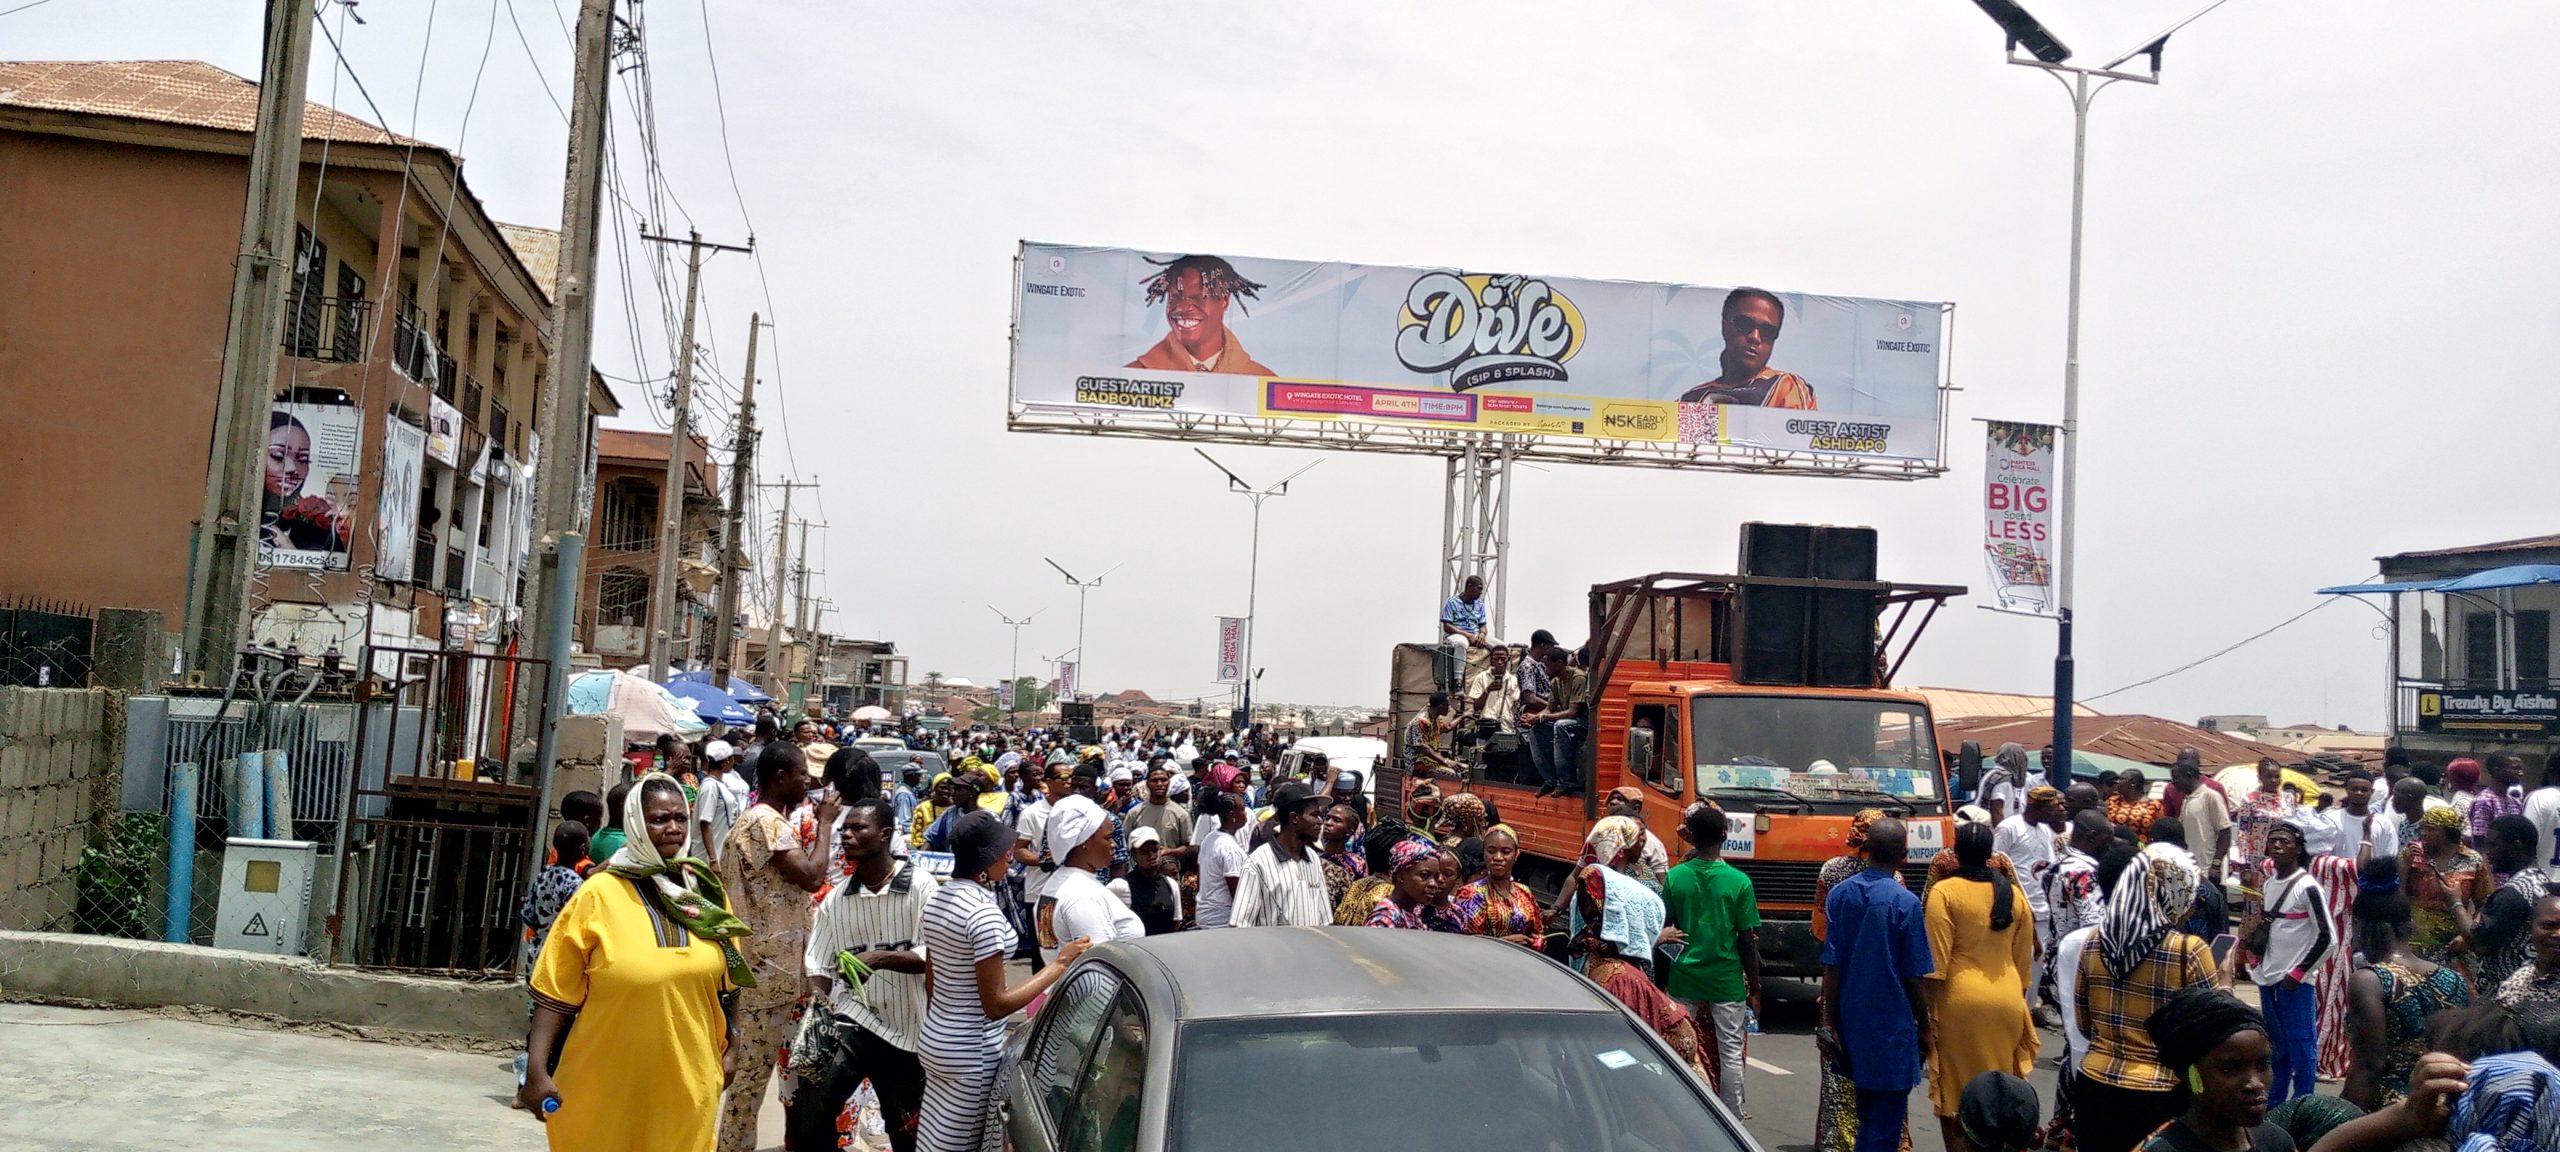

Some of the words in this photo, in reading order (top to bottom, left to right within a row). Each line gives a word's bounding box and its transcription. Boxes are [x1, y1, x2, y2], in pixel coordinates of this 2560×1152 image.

[1396, 272, 1573, 373] Dive
[1466, 372, 1490, 386] (SIP
[1494, 369, 1502, 379] &
[1505, 367, 1556, 379] SPLASH)
[1077, 377, 1128, 393] GUEST
[1130, 381, 1183, 397] ARTIST
[1077, 391, 1174, 408] BADBOYTIMZ
[1374, 399, 1400, 408] APRIL
[1401, 401, 1418, 409] 4TH
[1636, 414, 1666, 424] EARLY
[1636, 420, 1658, 430] BIRD
[1786, 419, 1837, 436] GUEST
[1837, 422, 1890, 439] ARTIST
[1810, 436, 1887, 453] ASHIDAPO
[1997, 474, 2041, 485] Celebrate
[1989, 482, 2048, 513] BIG
[2003, 510, 2032, 521] Spend
[1989, 520, 2047, 541] LESS
[2442, 694, 2495, 713] Trendy
[2493, 694, 2518, 714] By
[2514, 693, 2557, 709] Aisha
[1721, 839, 1751, 852] IFOAM
